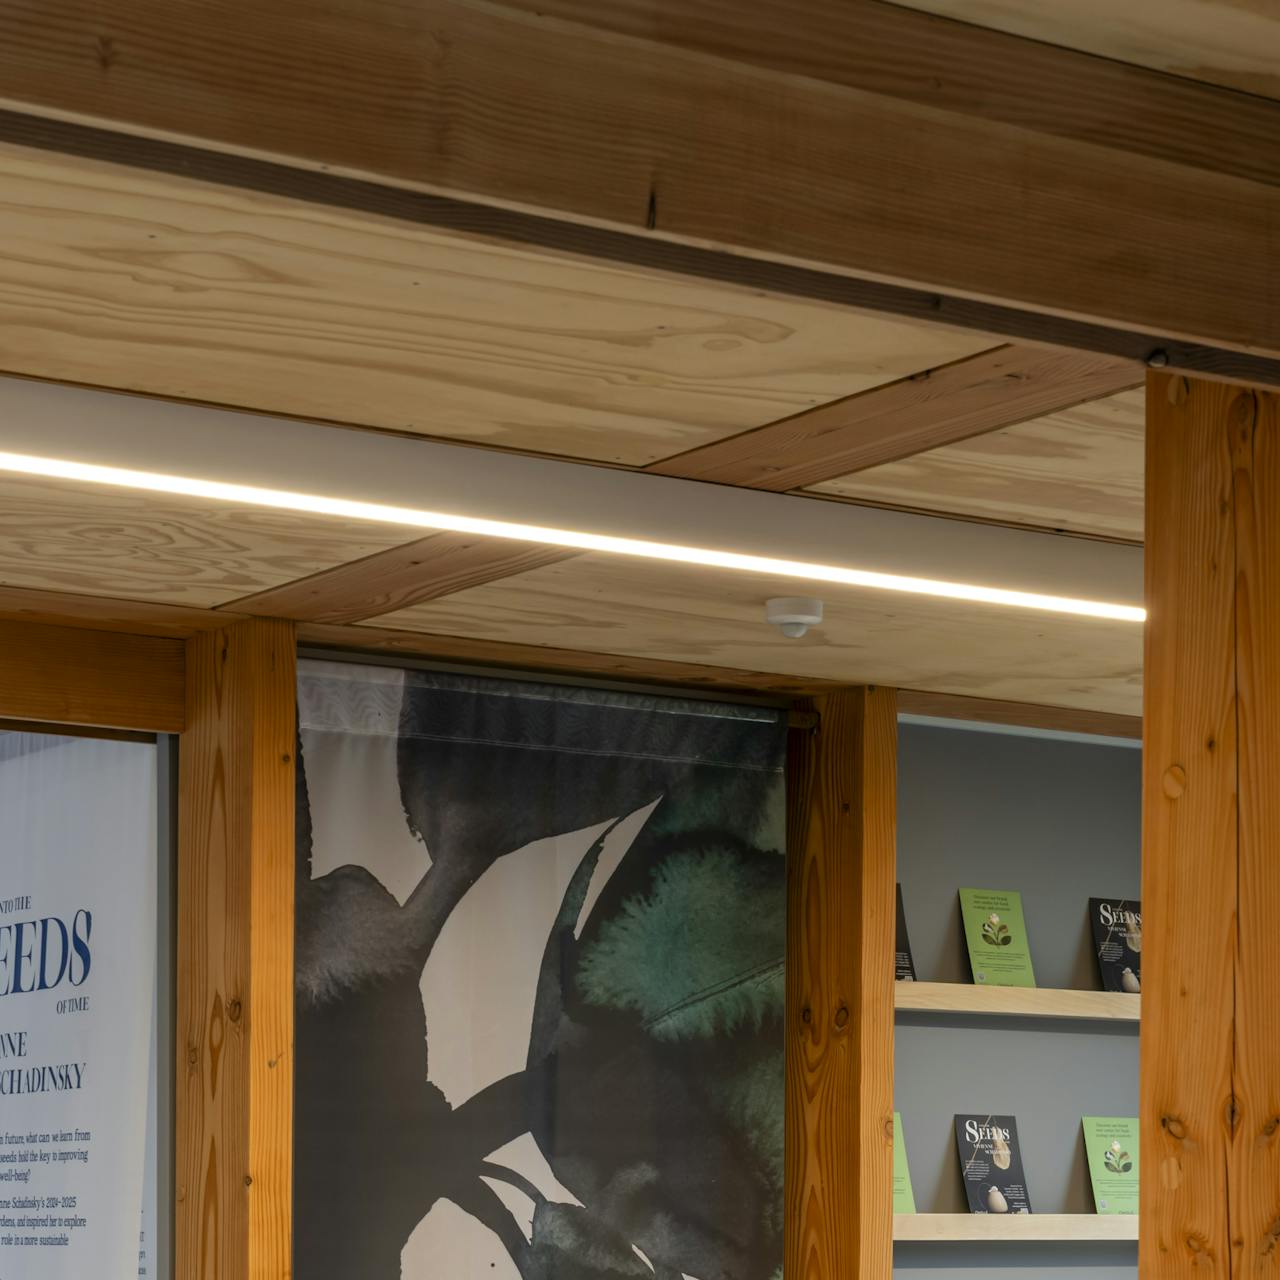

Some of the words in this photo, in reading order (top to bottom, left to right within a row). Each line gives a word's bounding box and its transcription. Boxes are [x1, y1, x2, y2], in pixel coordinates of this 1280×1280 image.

[14, 896, 32, 910] THE
[1100, 903, 1141, 925] SEEDS
[56, 1000, 68, 1015] OF
[68, 997, 90, 1013] TIME
[39, 1134, 50, 1143] can
[74, 1129, 90, 1141] from
[965, 1120, 1010, 1143] SEEDS
[0, 1151, 16, 1163] seeds
[39, 1149, 50, 1164] key
[58, 1148, 88, 1164] improving
[64, 1215, 86, 1230] explore
[1, 1233, 13, 1245] role
